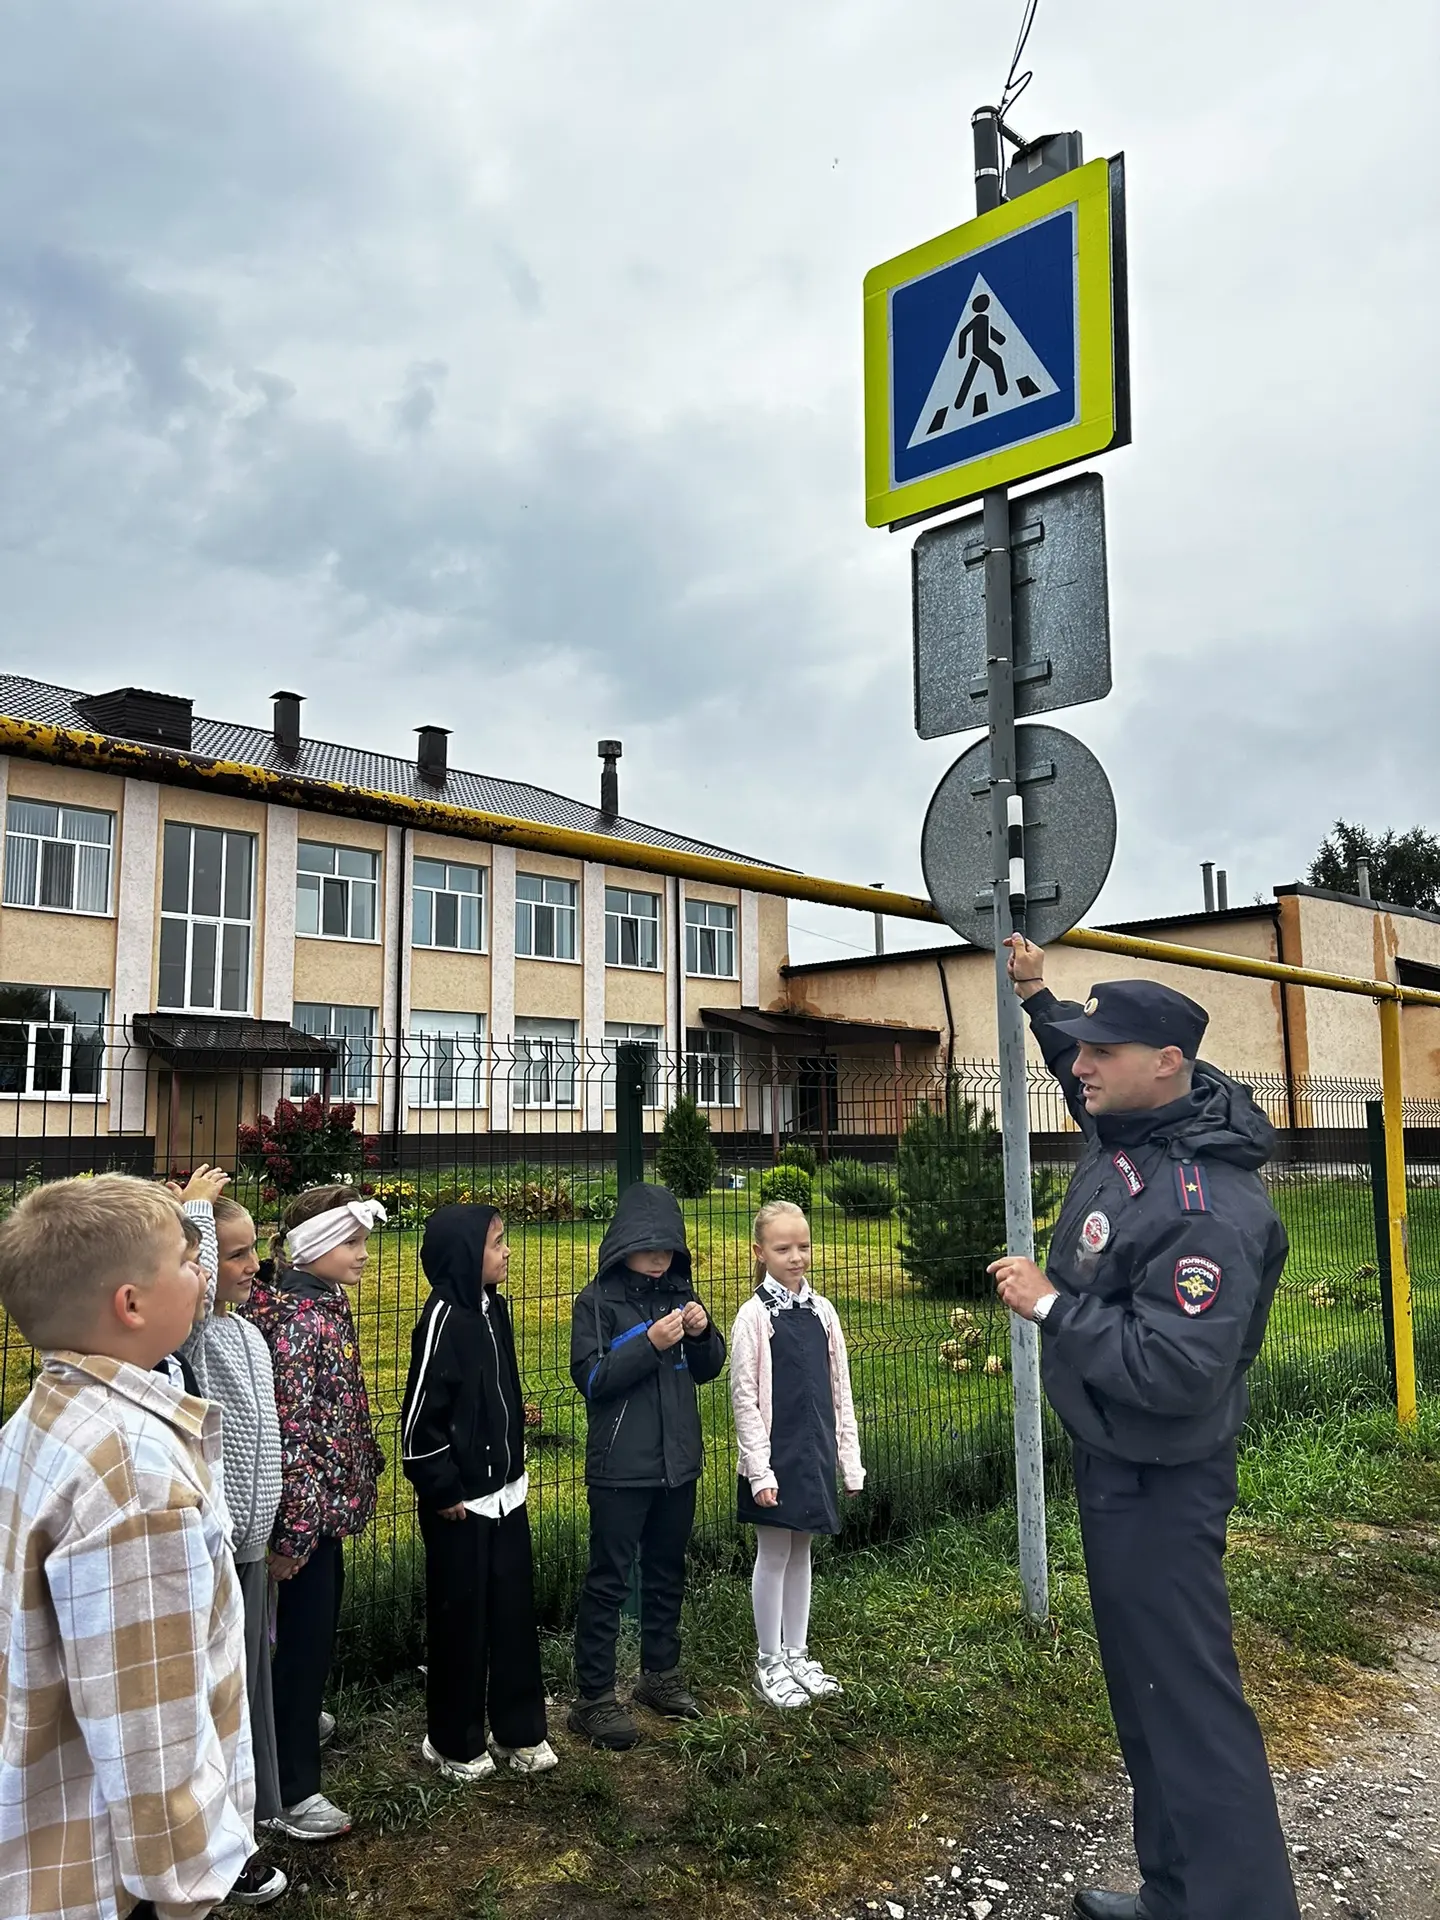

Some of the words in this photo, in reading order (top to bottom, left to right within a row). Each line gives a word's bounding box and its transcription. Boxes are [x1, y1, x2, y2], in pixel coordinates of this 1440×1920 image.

[1115, 1156, 1131, 1173] ДПС
[1179, 1258, 1220, 1275] ПОЛИЦИЯ
[1181, 1266, 1214, 1282] РОССИЯ
